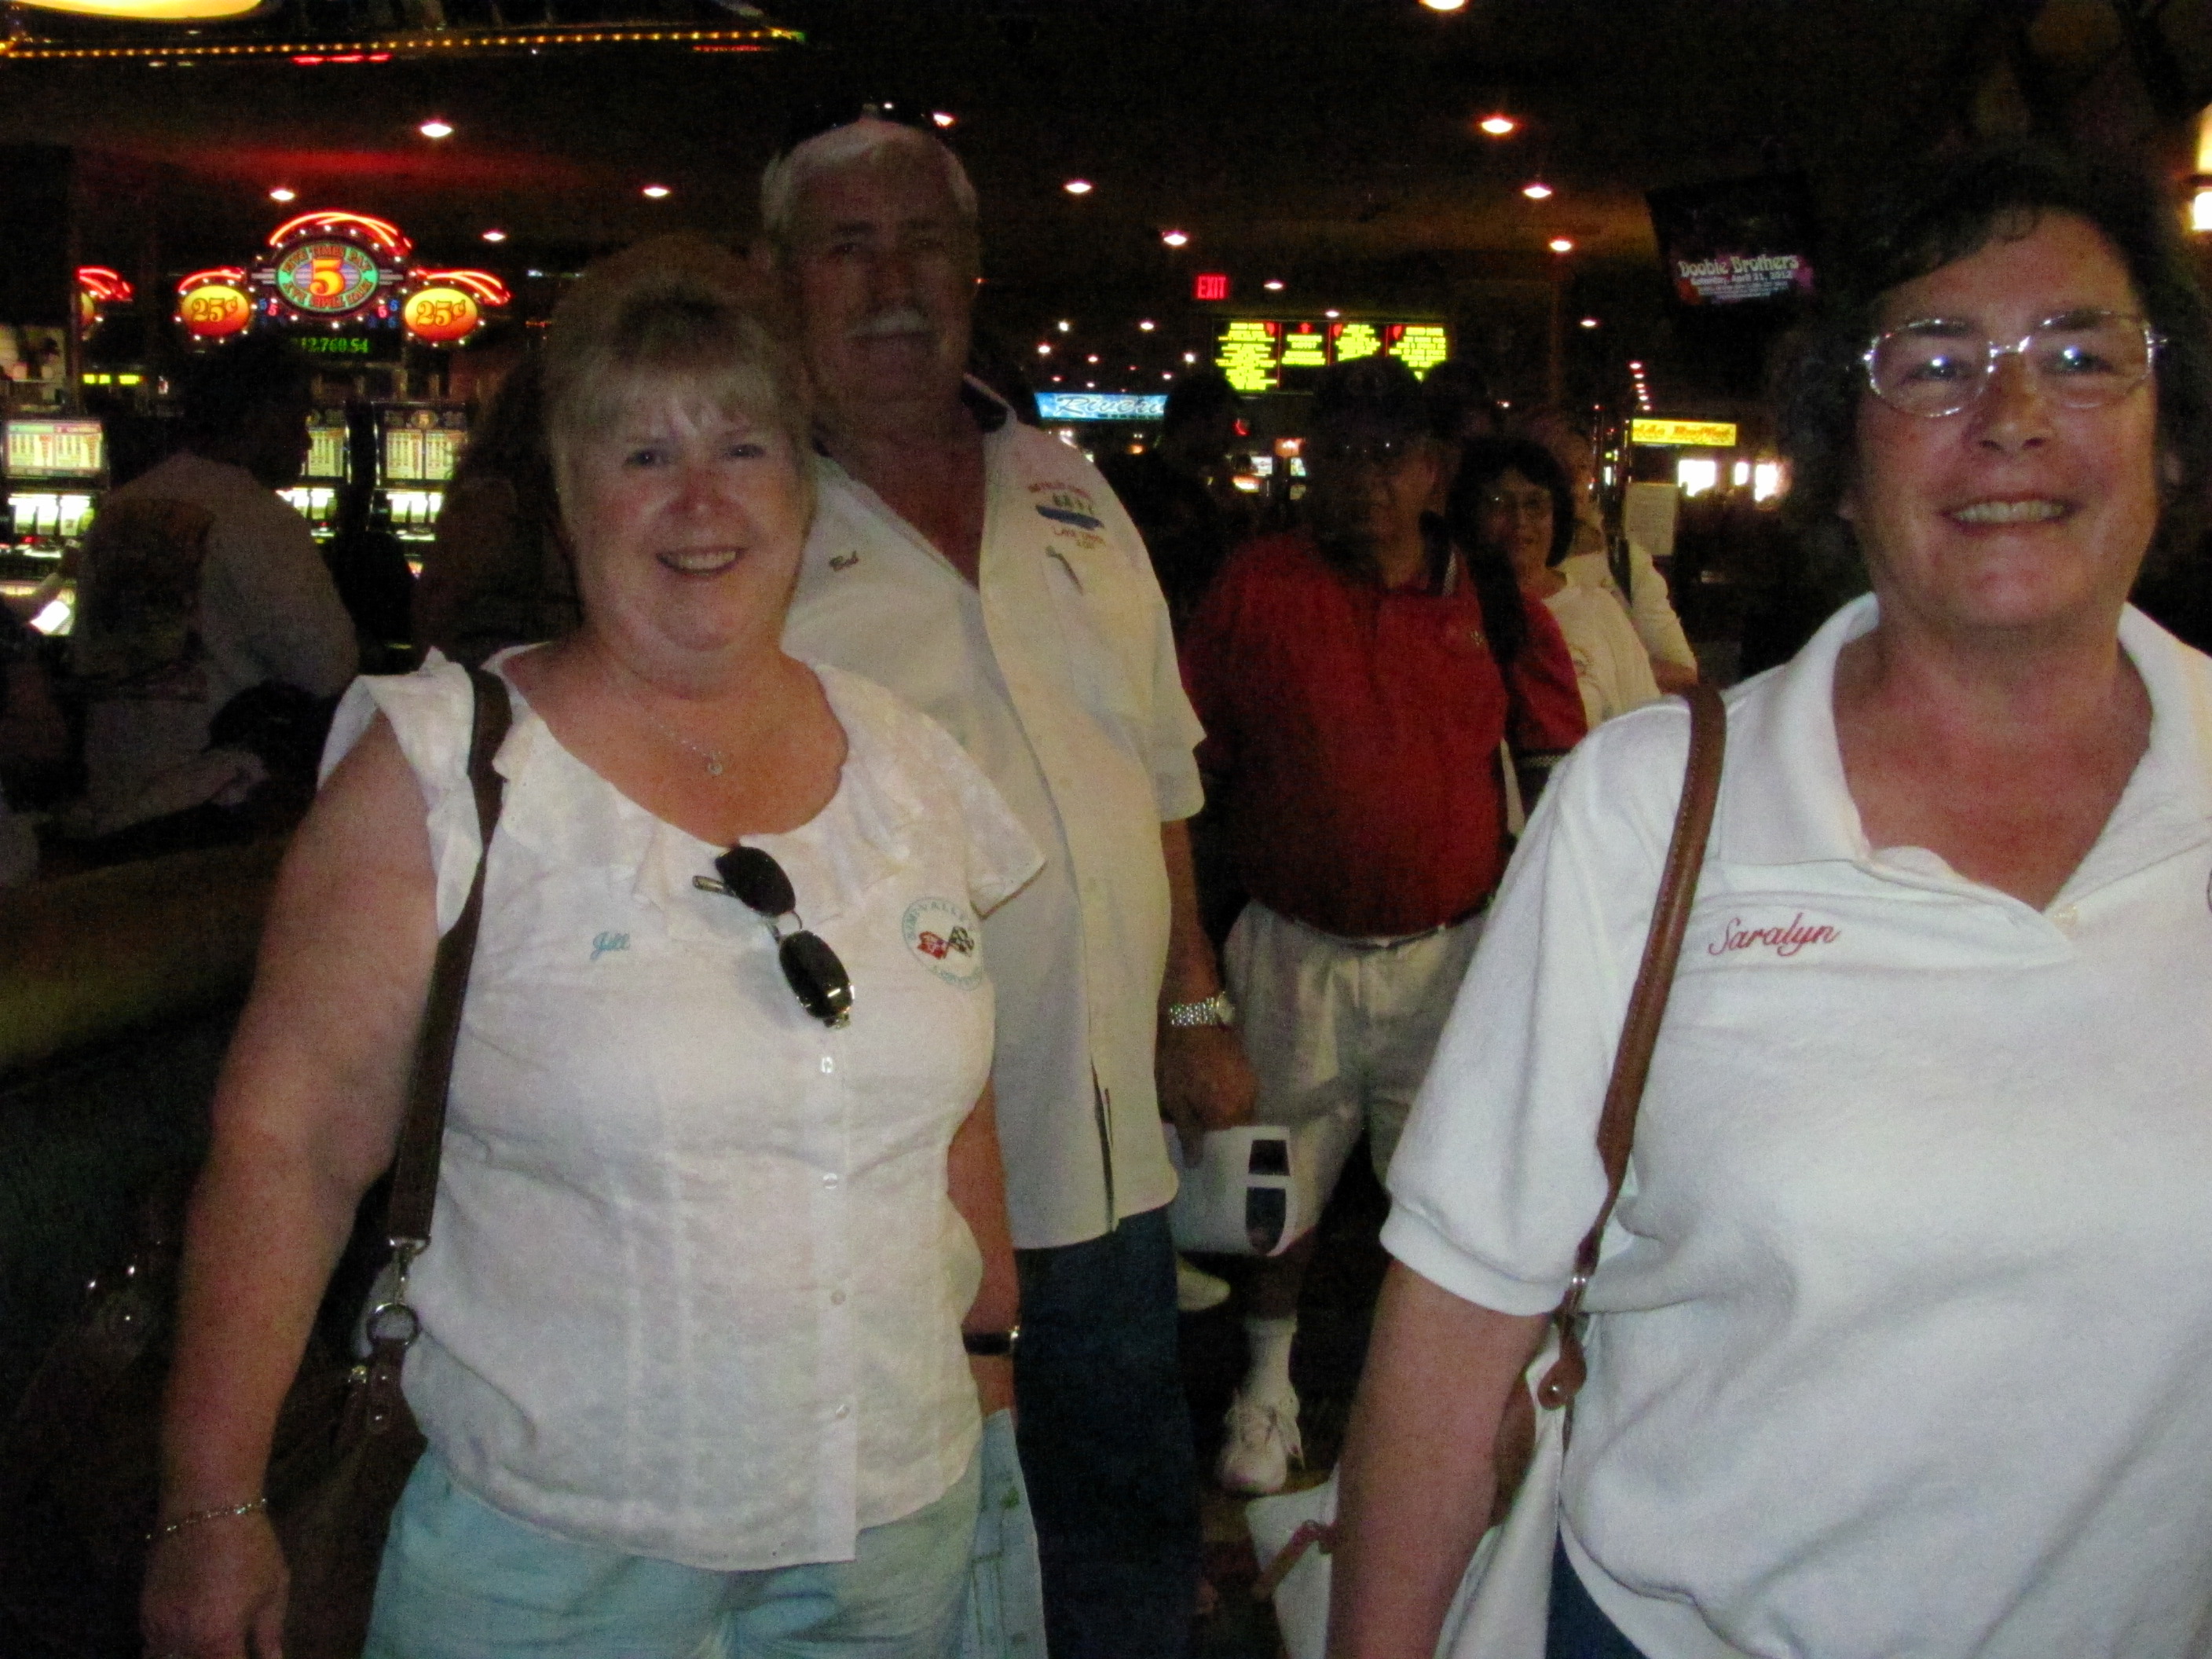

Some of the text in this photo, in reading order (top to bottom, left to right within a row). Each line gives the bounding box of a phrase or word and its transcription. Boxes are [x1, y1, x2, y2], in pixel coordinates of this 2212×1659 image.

[309, 258, 346, 296] 5
[1679, 254, 1800, 277] Doobie Brothers
[1198, 276, 1226, 298] EXIT
[192, 296, 239, 323] 25¢
[416, 299, 467, 327] 25¢
[1708, 911, 1841, 958] Saralyn
